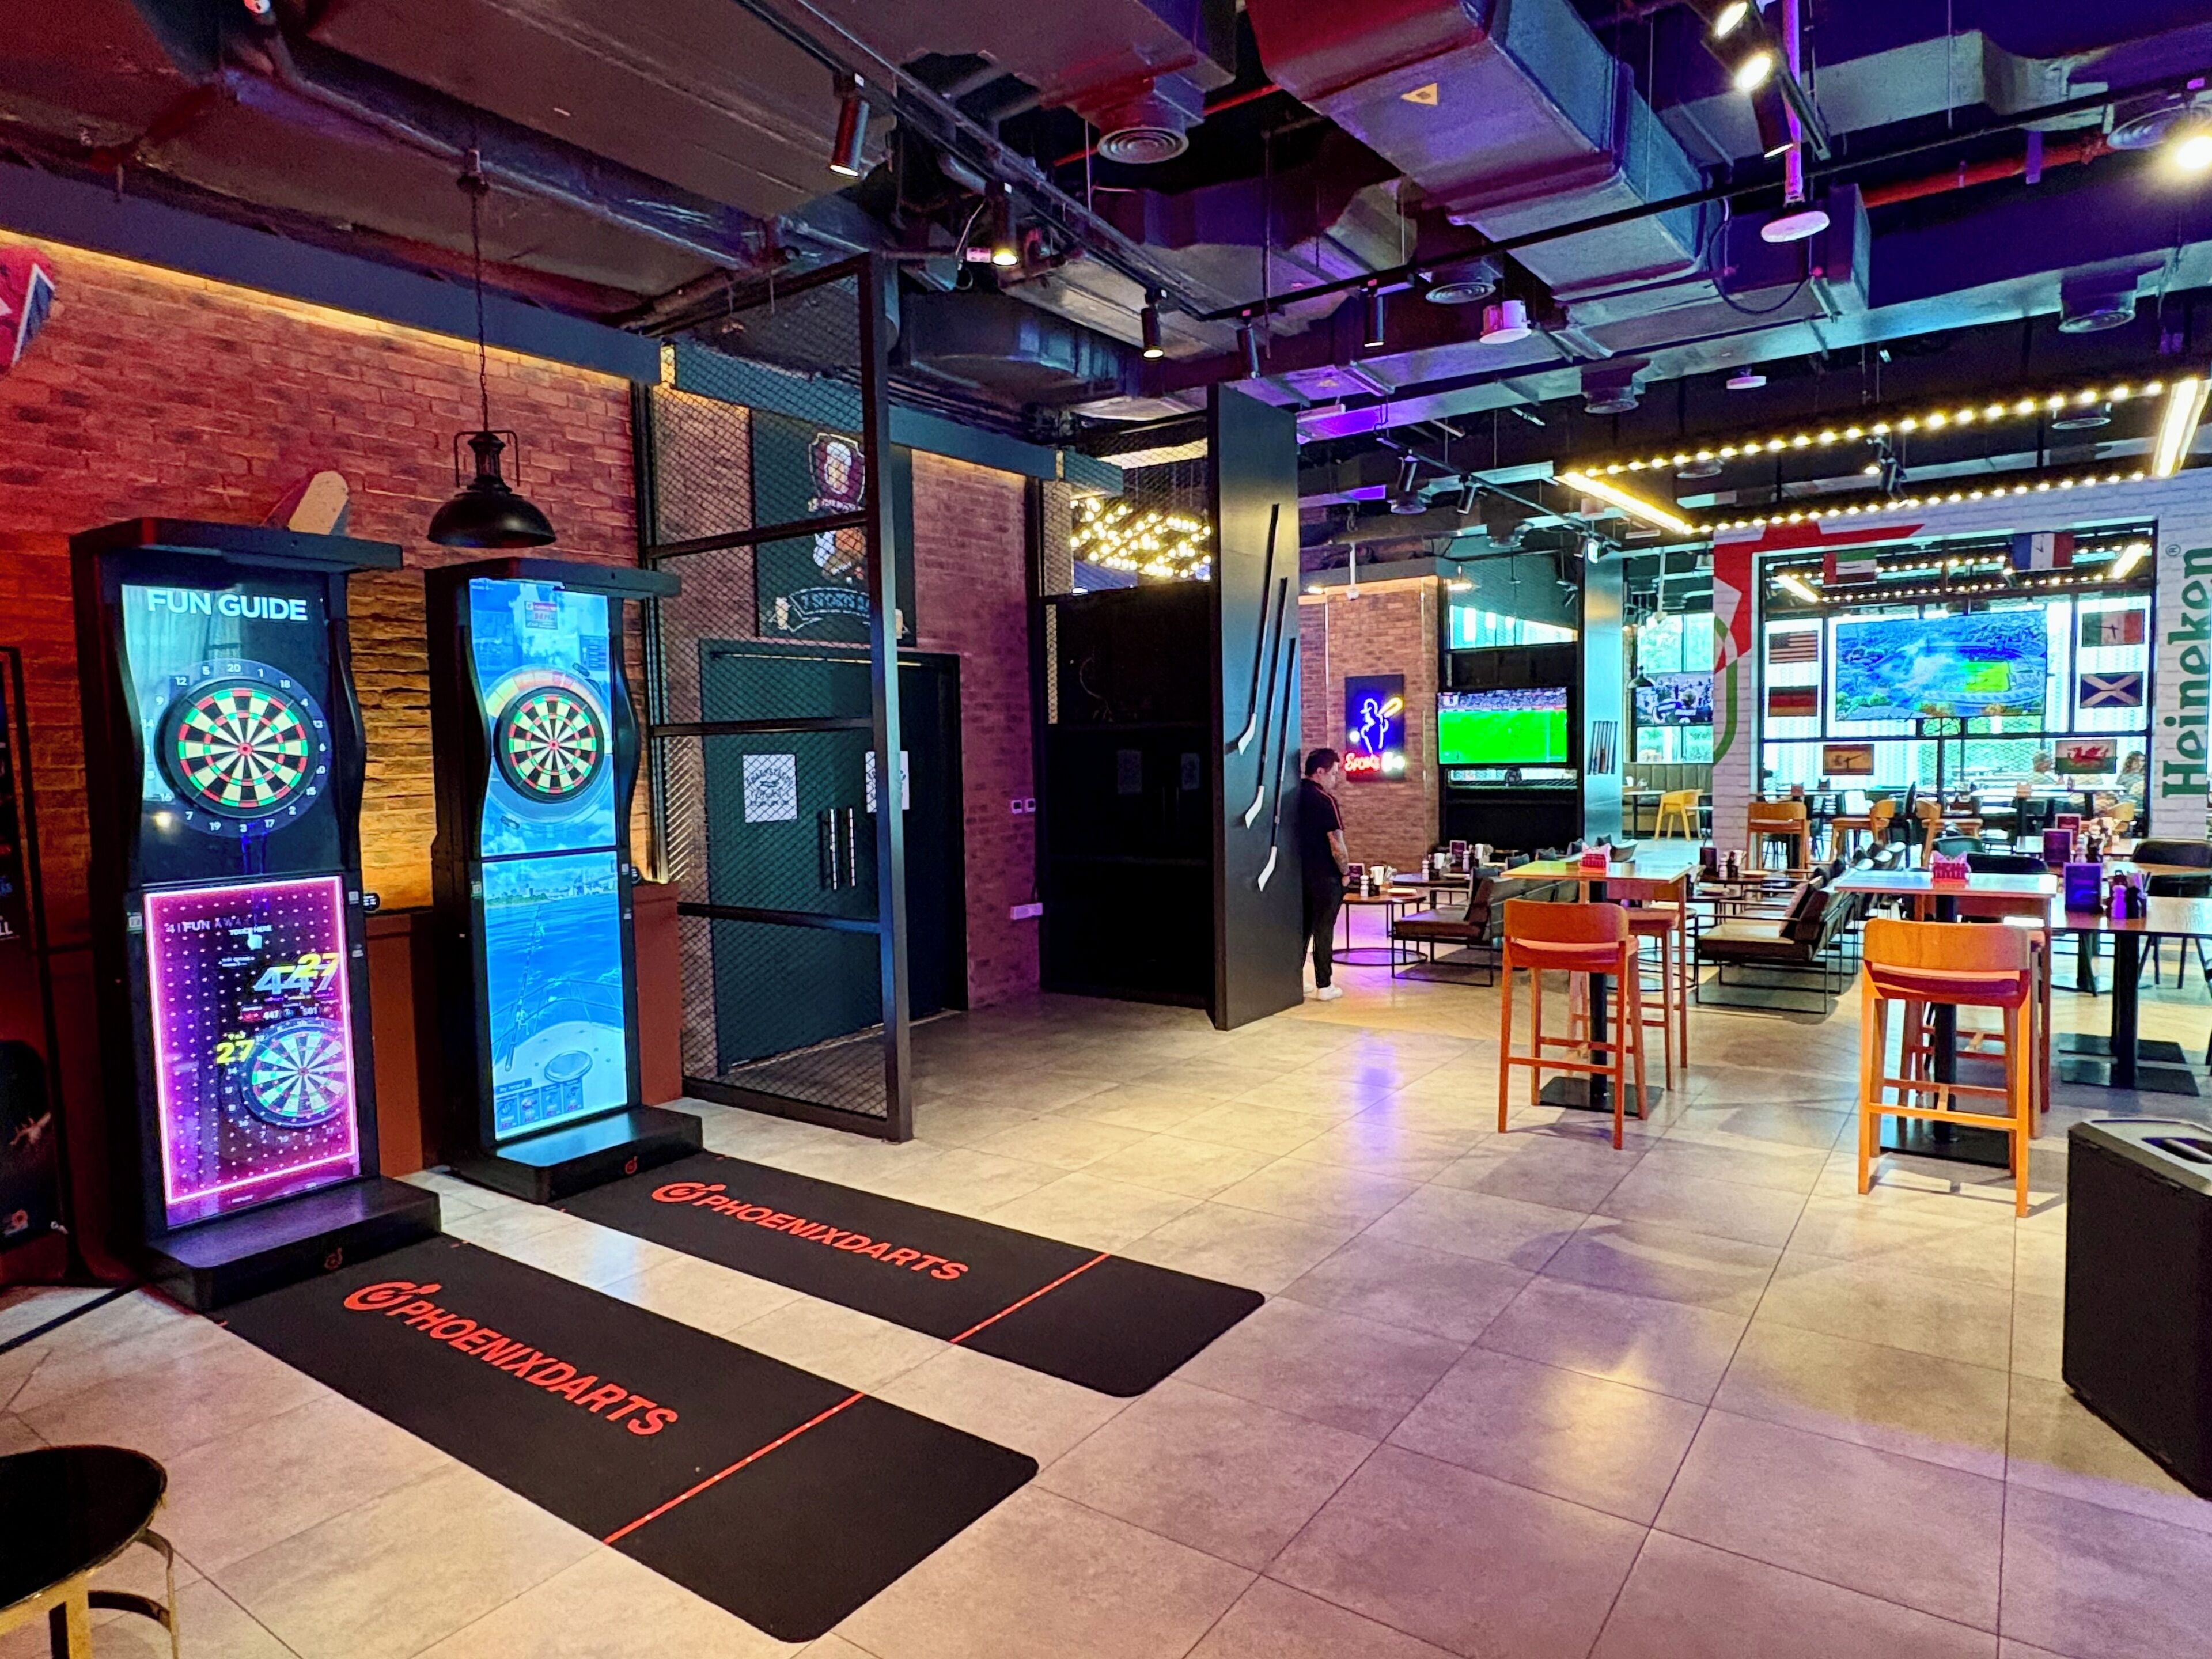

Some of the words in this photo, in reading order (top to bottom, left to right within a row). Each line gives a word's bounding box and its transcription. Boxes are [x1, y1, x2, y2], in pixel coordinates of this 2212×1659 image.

[147, 589, 211, 615] FUN
[218, 594, 308, 621] GUIDE
[202, 666, 210, 675] 5
[227, 664, 241, 672] 20
[2162, 547, 2212, 798] Heineken
[258, 669, 264, 678] 1
[175, 677, 187, 685] 12
[280, 680, 291, 688] 18
[156, 696, 164, 705] 9
[160, 793, 172, 802] 16
[185, 811, 193, 820] 7
[289, 807, 296, 816] 2
[209, 822, 221, 831] 19
[240, 824, 248, 832] 3
[264, 819, 275, 828] 17
[216, 1039, 254, 1063] 27
[702, 1194, 969, 1280] PHOENIXDARTS
[404, 1299, 679, 1435] PHOENIXDARTS
